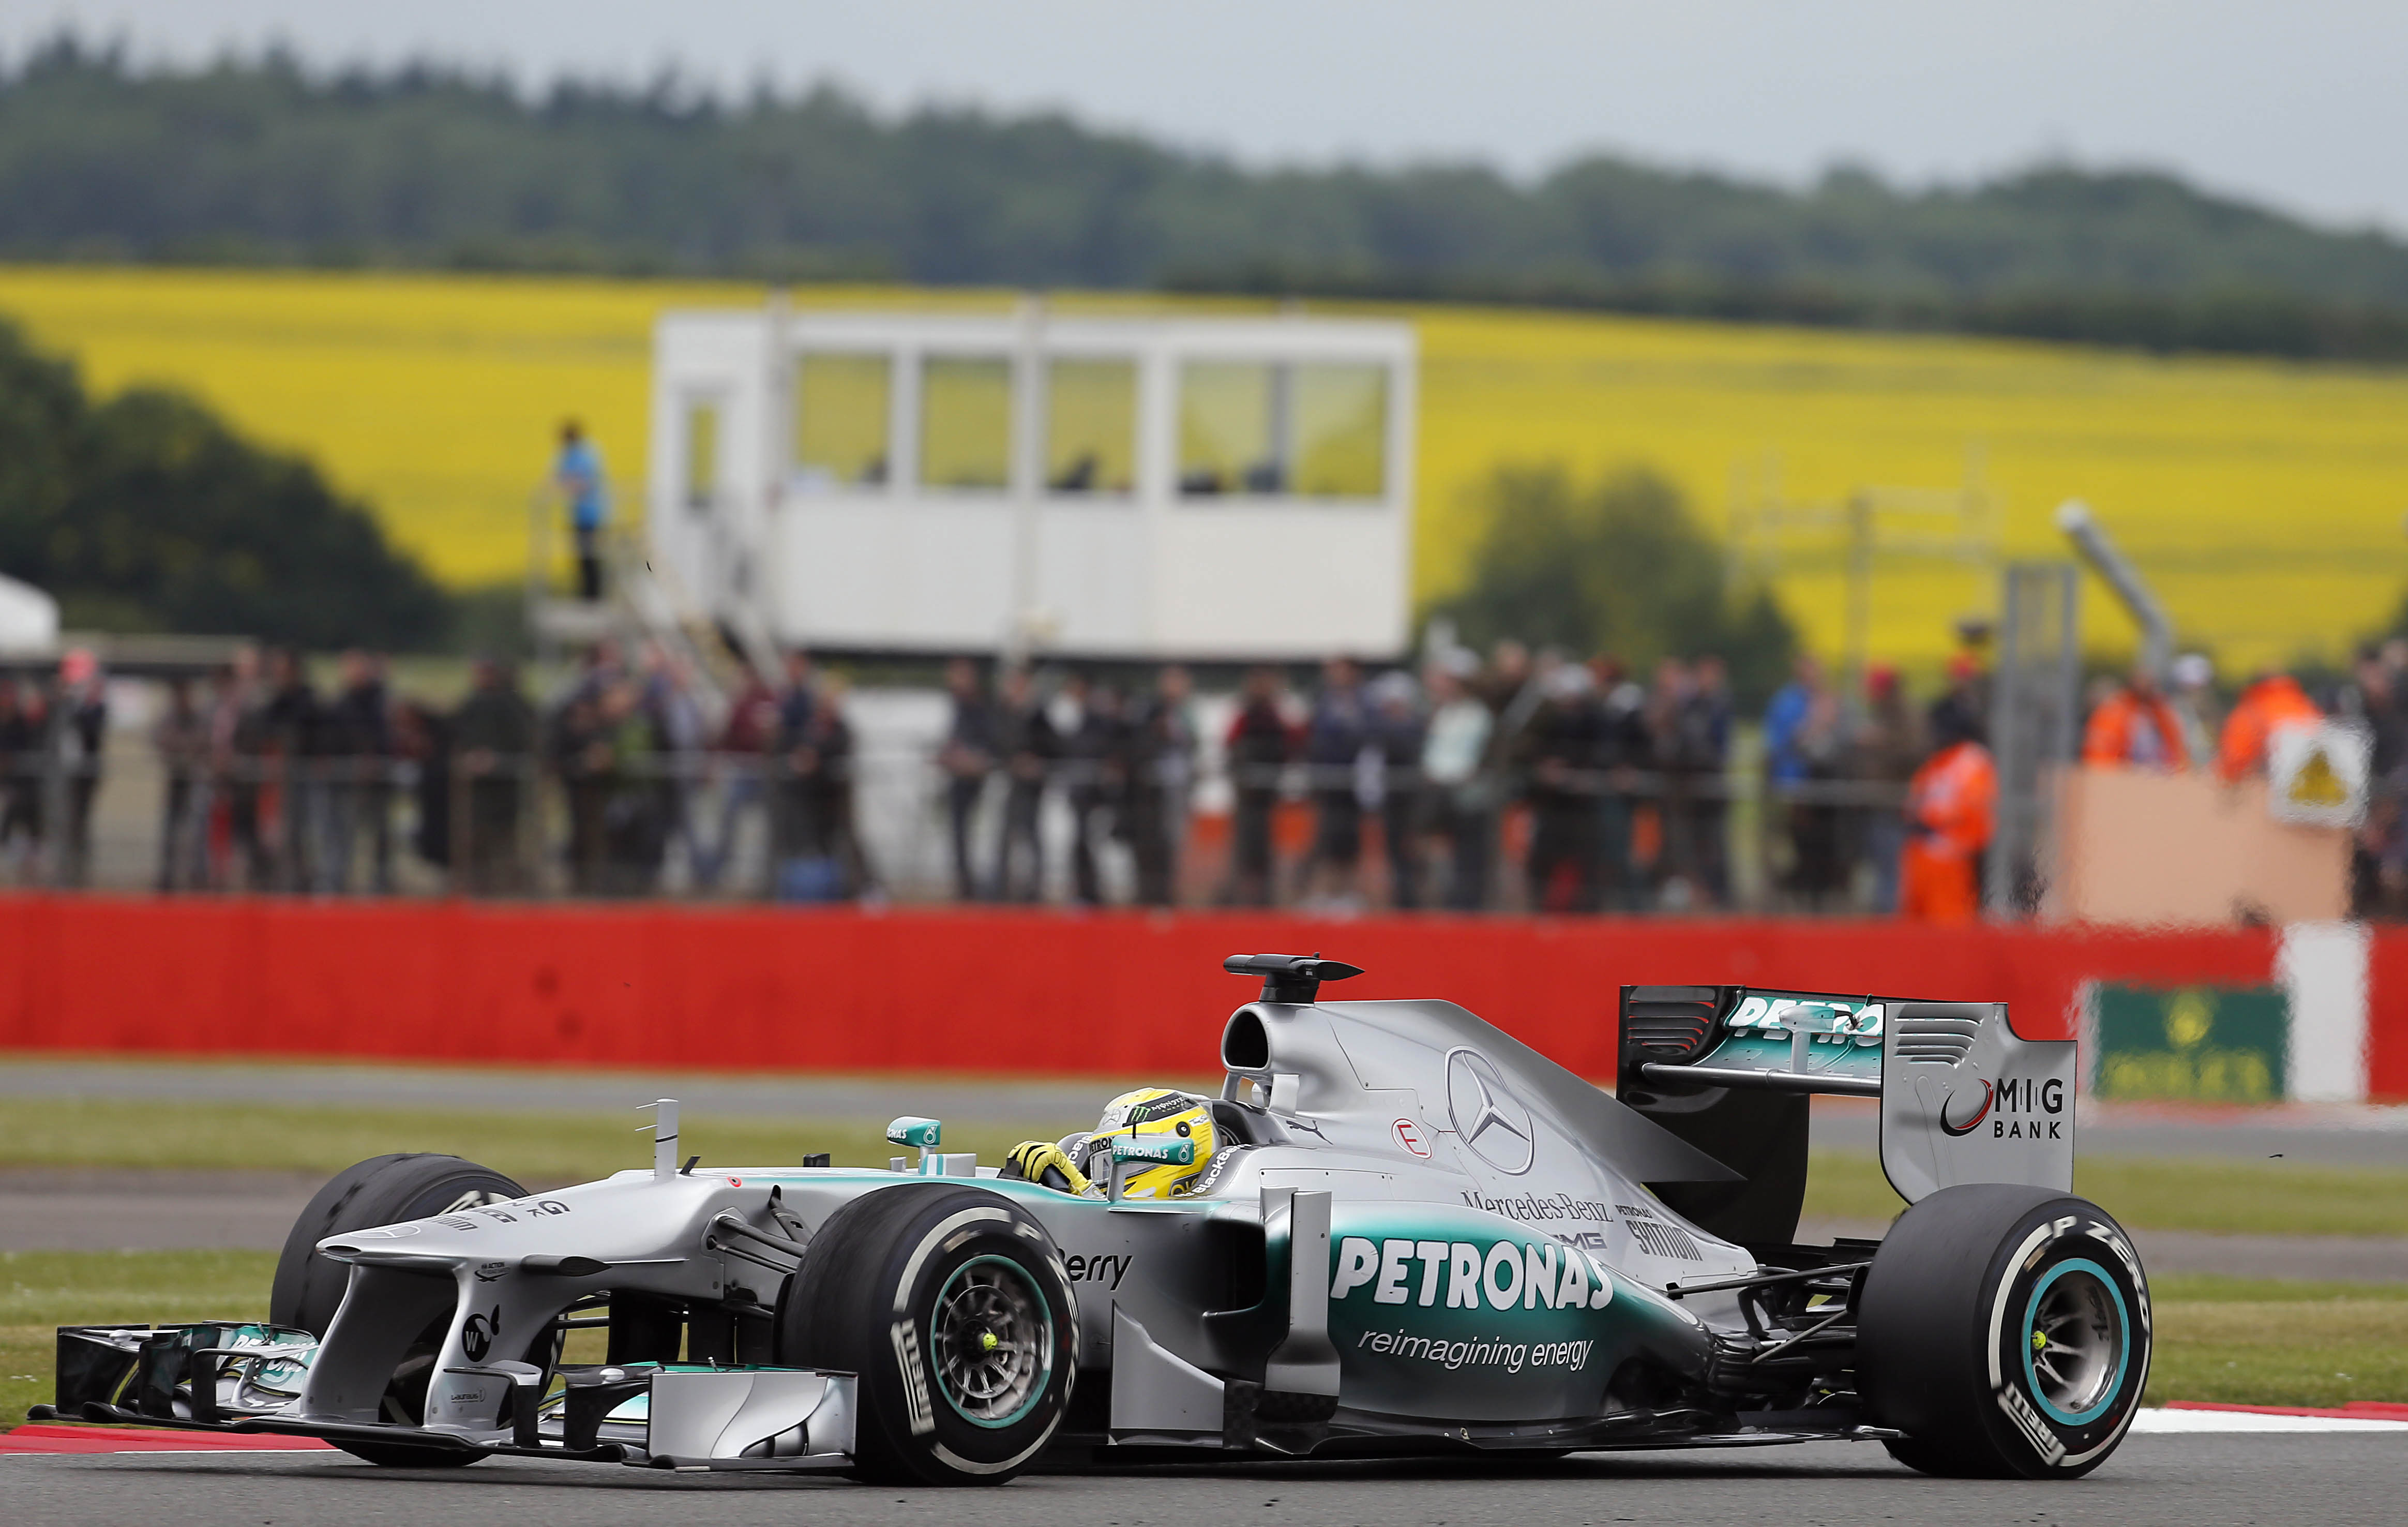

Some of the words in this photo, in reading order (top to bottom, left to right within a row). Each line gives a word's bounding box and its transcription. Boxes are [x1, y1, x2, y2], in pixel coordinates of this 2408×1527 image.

[1396, 1124, 1428, 1156] E
[1994, 1120, 2061, 1139] BANK
[1112, 1145, 1169, 1159] PETRONAS
[1461, 1191, 1614, 1222] Mercedes-Benz
[1615, 1204, 1653, 1219] PETRONAS
[1330, 1236, 1614, 1312] PETRONAS
[465, 1330, 479, 1352] W
[1357, 1328, 1527, 1373] reimagining
[1530, 1340, 1594, 1372] energy
